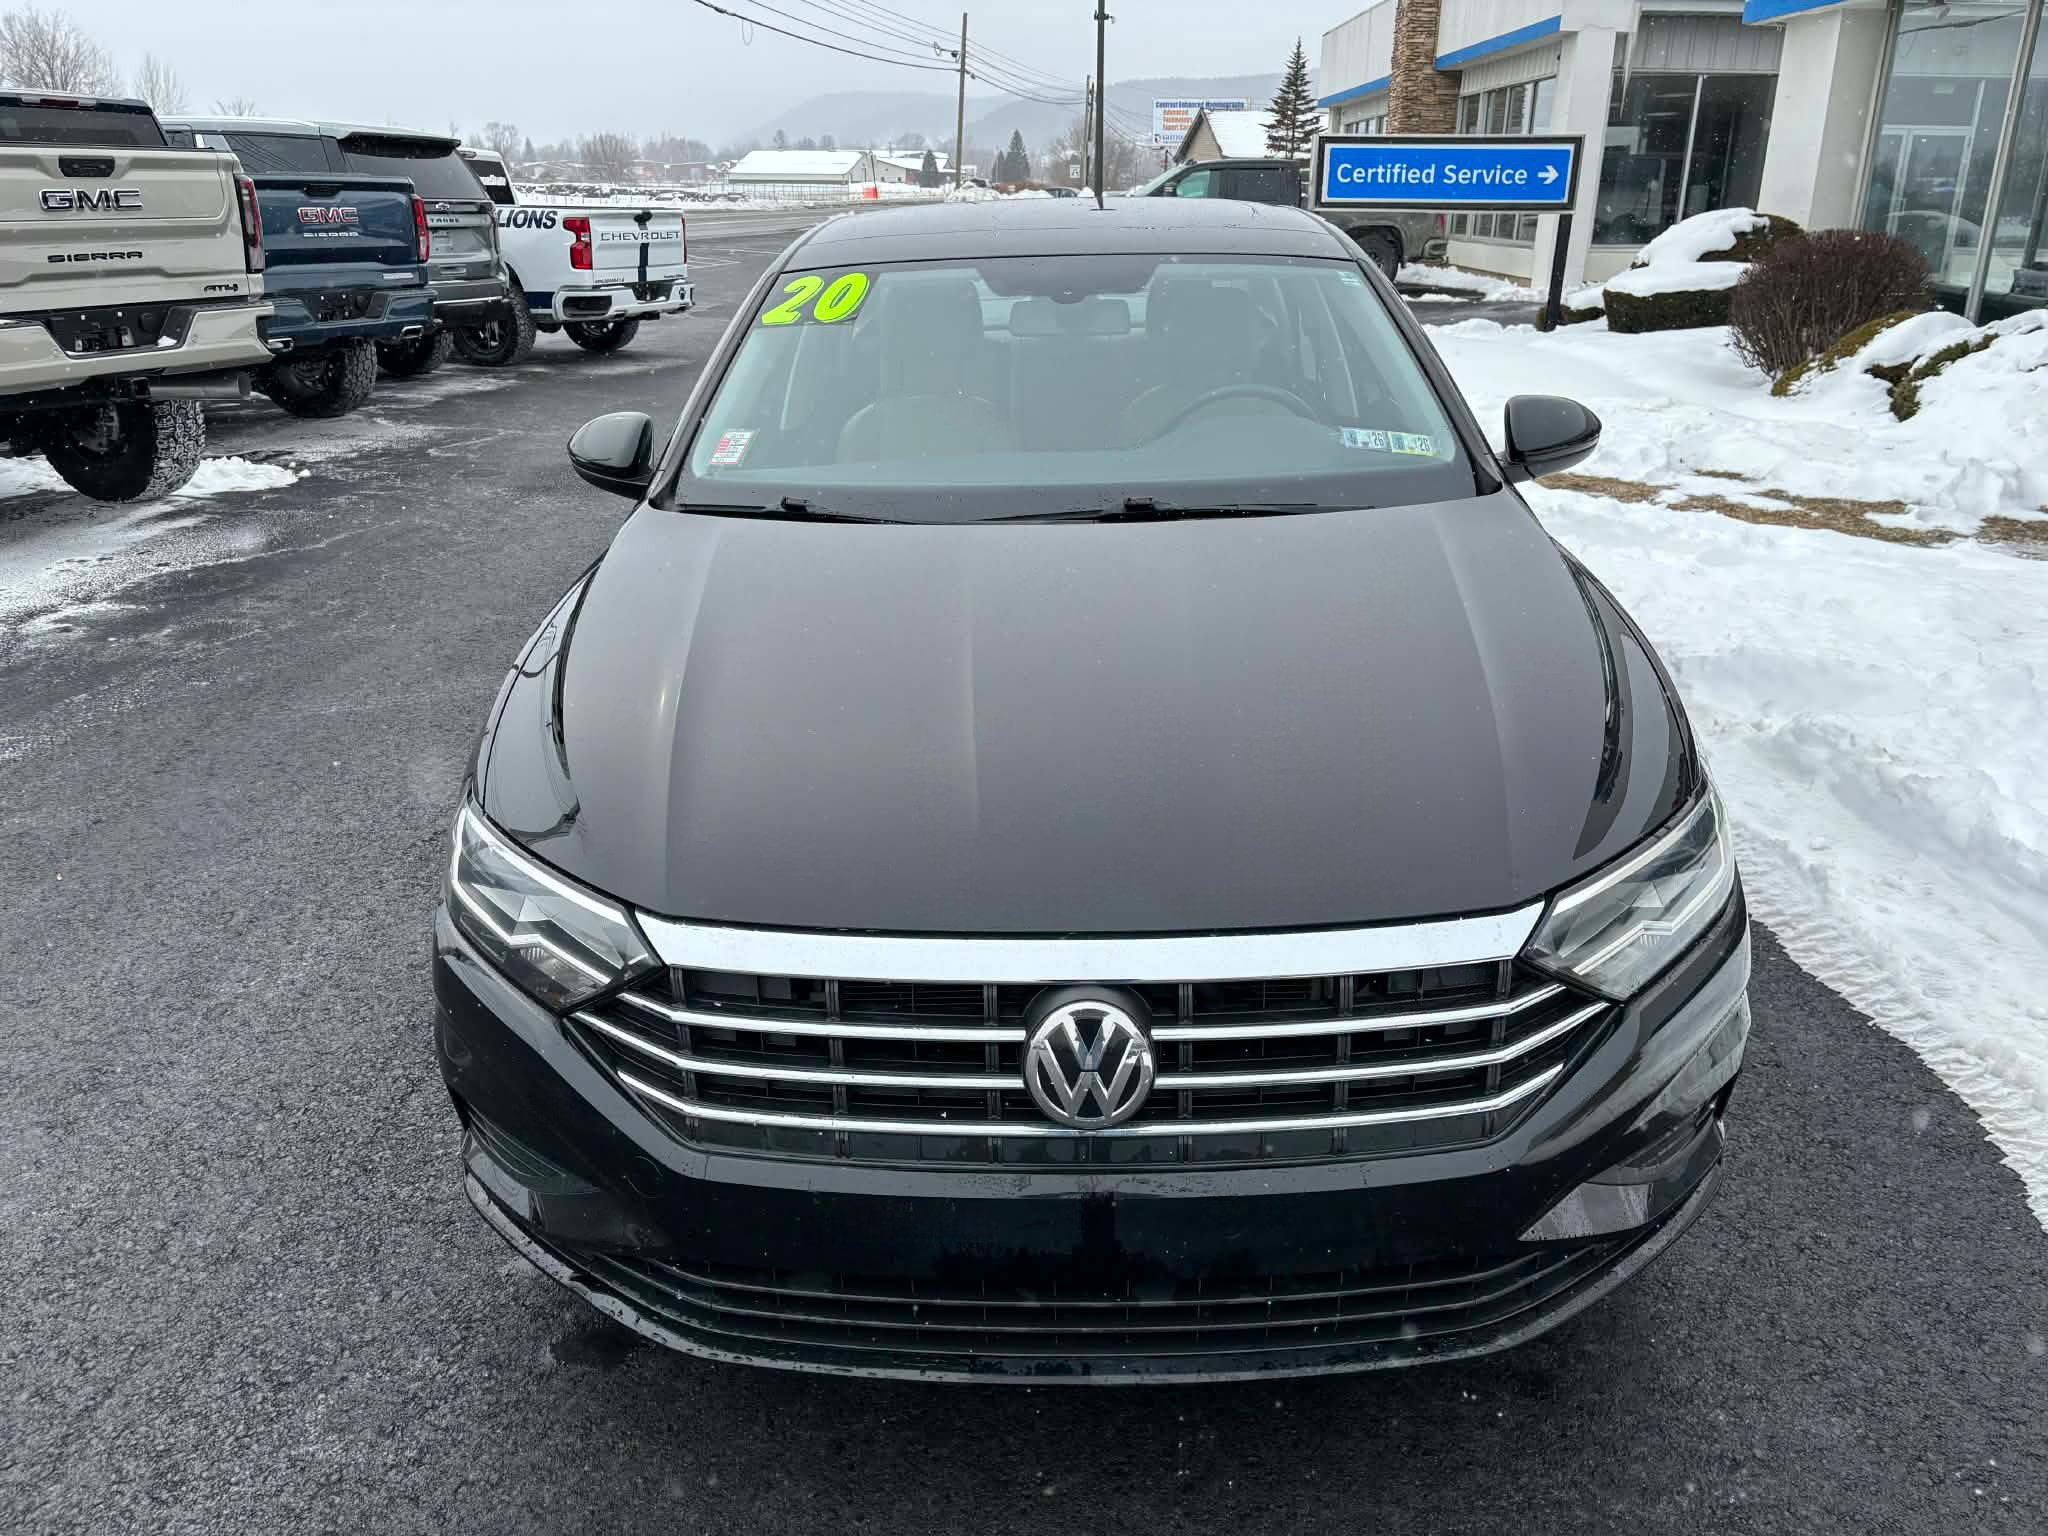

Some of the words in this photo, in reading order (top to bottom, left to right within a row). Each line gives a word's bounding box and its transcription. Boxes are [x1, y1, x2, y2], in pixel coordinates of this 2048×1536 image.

[1337, 163, 1435, 184] Certified
[1443, 164, 1528, 185] Service
[39, 188, 143, 211] GMC
[298, 207, 358, 224] GMC
[497, 209, 558, 230] LIONS
[601, 231, 680, 241] CHEVROLET
[47, 251, 143, 263] SIERRA
[203, 283, 238, 292] AT4
[762, 272, 869, 326] 20
